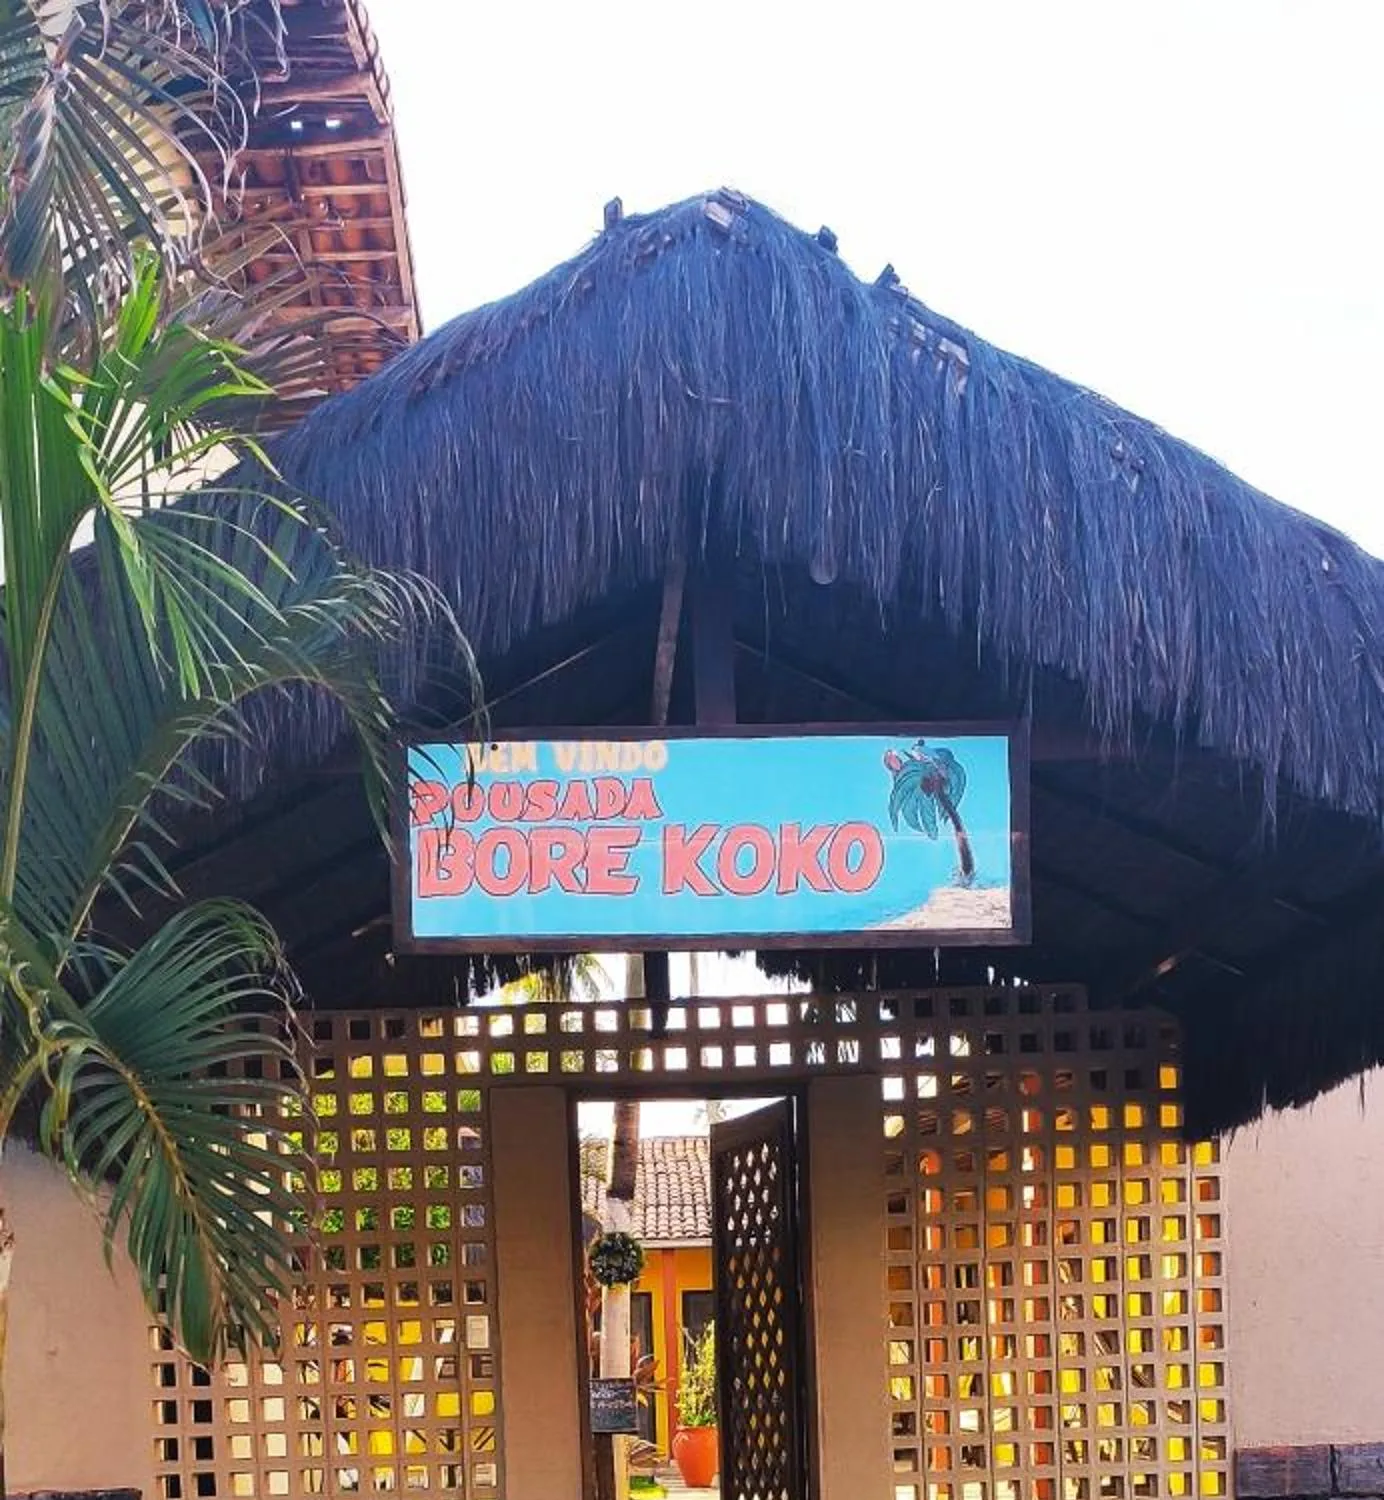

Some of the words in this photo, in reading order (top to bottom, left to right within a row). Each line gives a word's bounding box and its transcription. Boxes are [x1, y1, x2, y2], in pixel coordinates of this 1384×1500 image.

[466, 742, 538, 773] BEM
[553, 741, 669, 773] VINDO
[411, 776, 663, 825] POUSADA
[417, 826, 642, 898] BORE
[662, 821, 885, 896] KOKO
